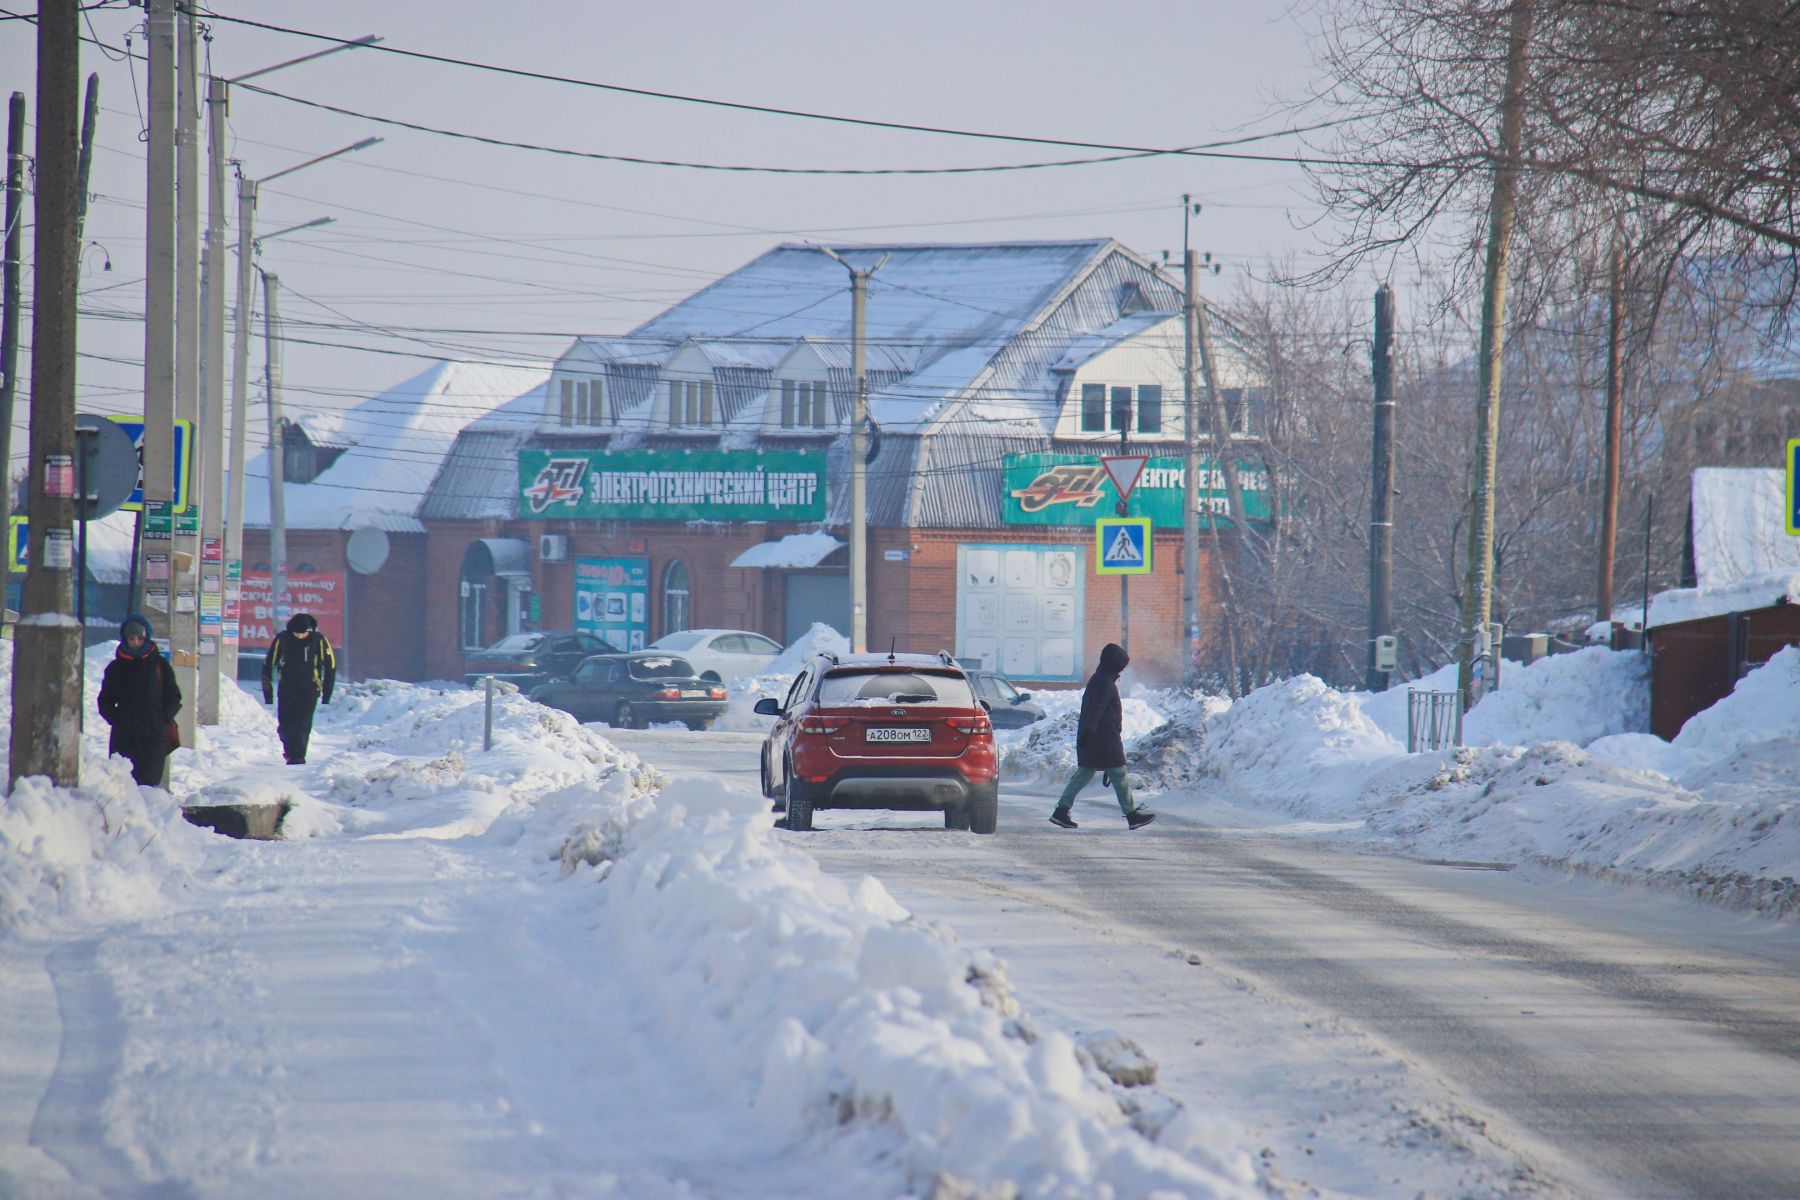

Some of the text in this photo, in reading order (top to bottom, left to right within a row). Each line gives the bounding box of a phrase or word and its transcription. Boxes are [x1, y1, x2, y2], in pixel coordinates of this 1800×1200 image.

[590, 465, 817, 509] ЭЛЕКТРОТЕХНИЧЕСКИЙ ЦЕНТР
[913, 729, 928, 738] 122
